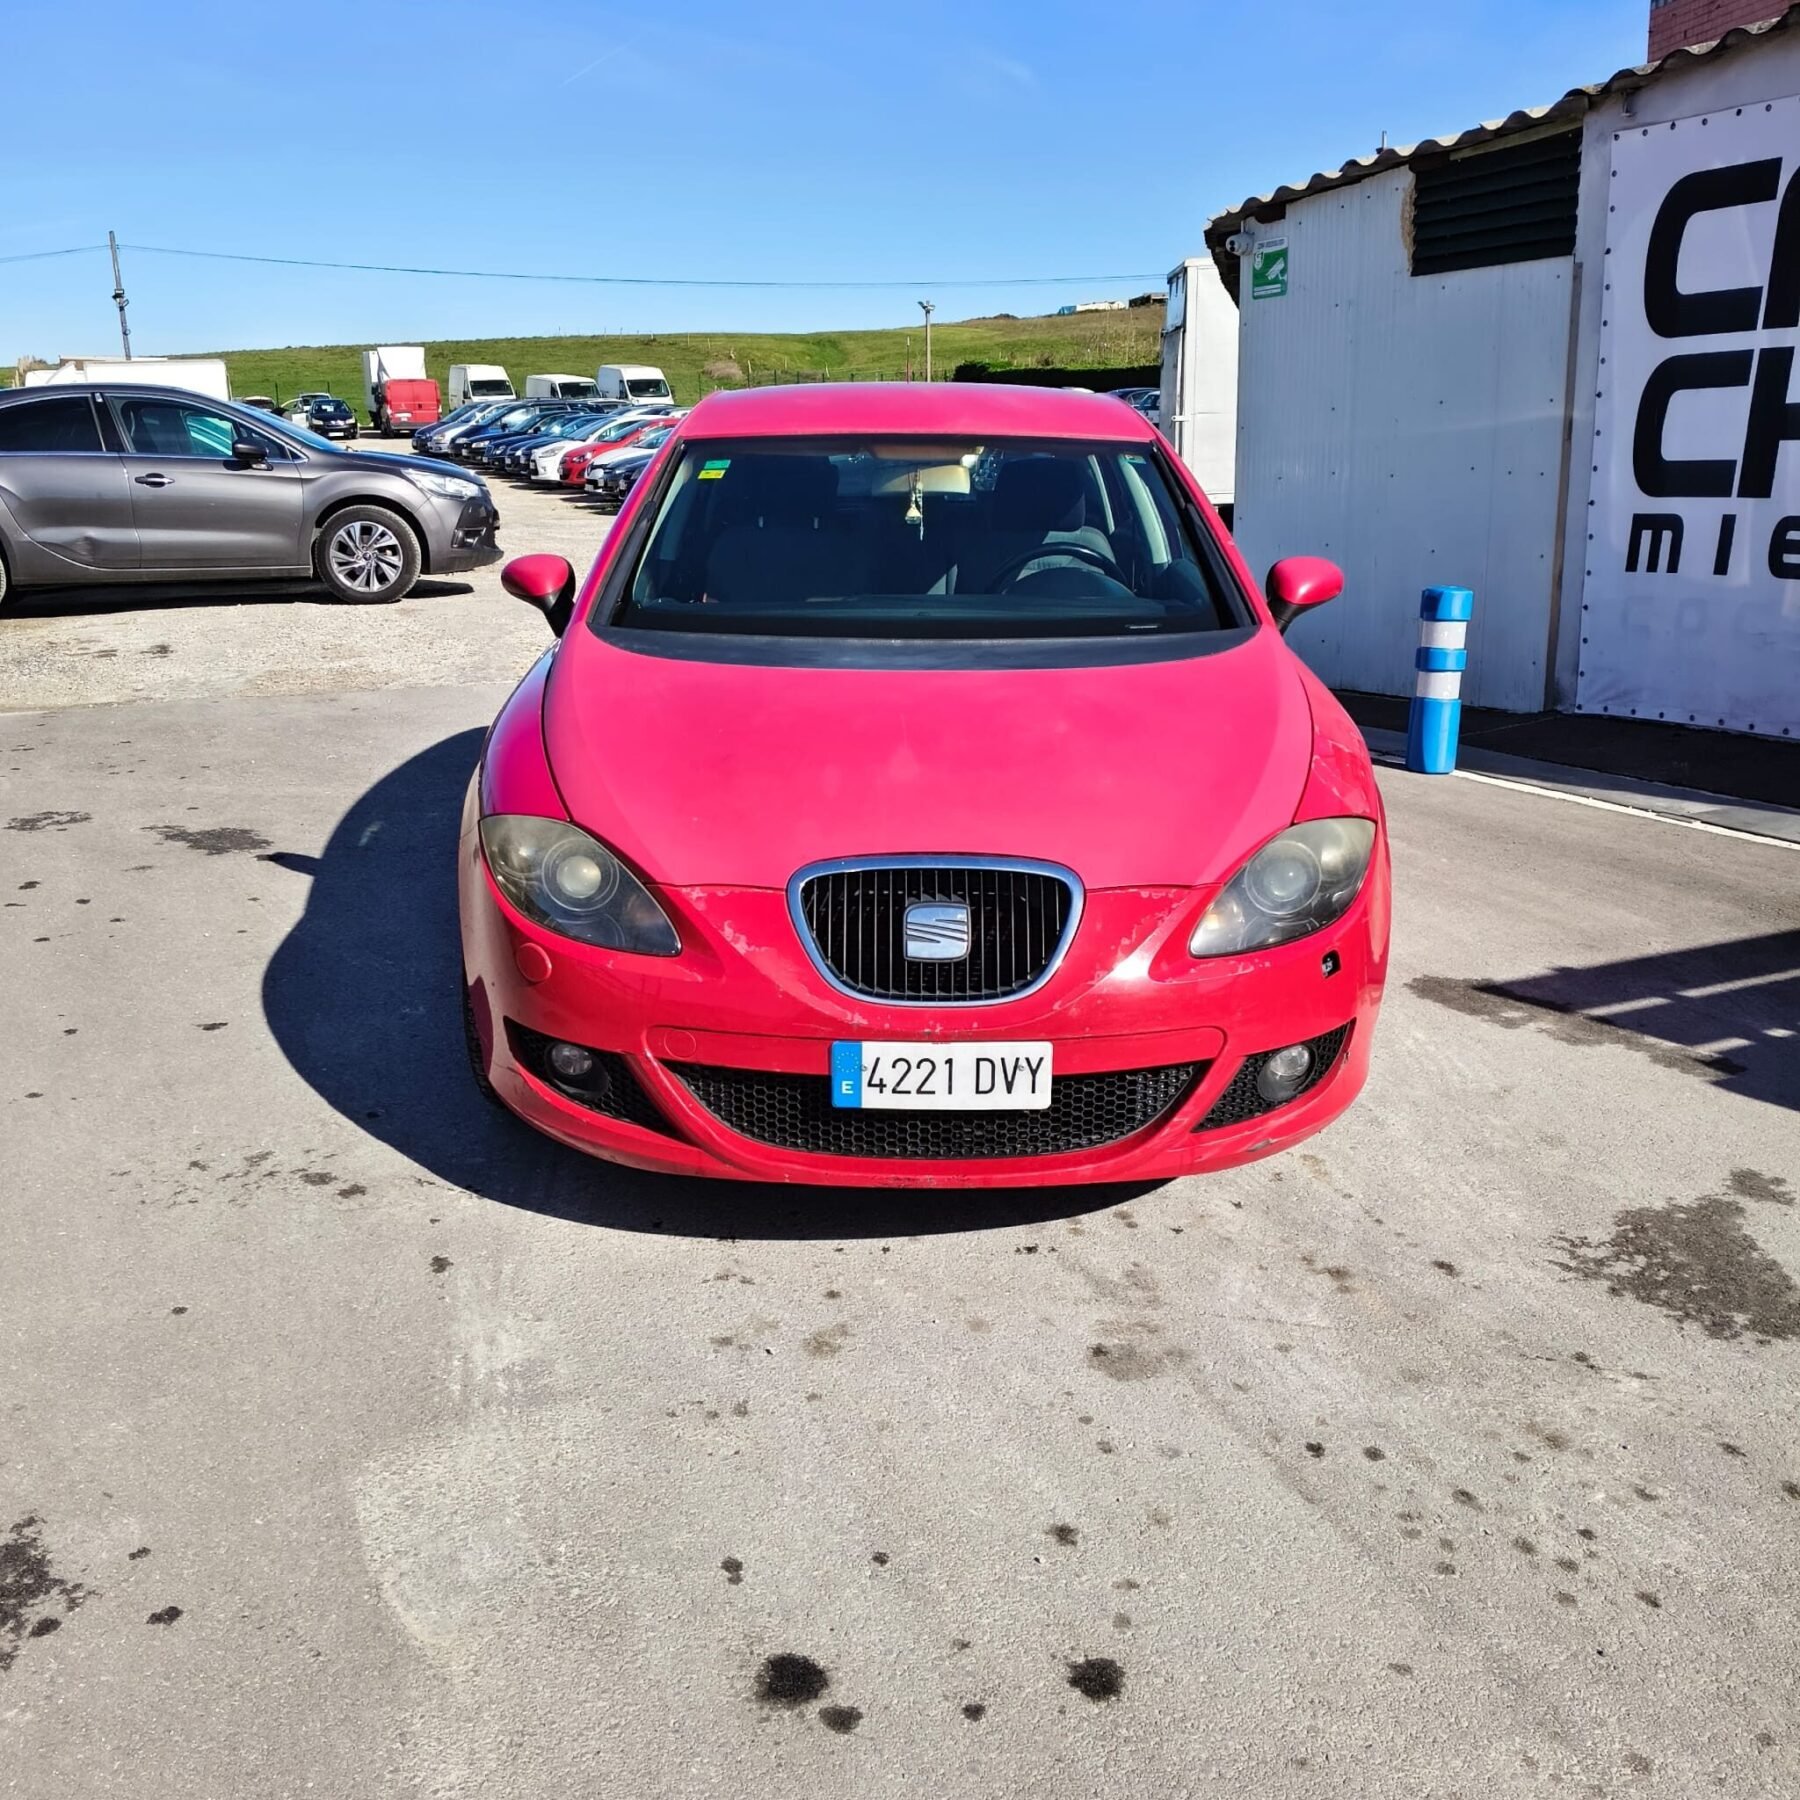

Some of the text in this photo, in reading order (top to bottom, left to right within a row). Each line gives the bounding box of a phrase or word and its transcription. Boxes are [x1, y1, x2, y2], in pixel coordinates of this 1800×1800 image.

[841, 1056, 1045, 1095] E 4221 DVY
